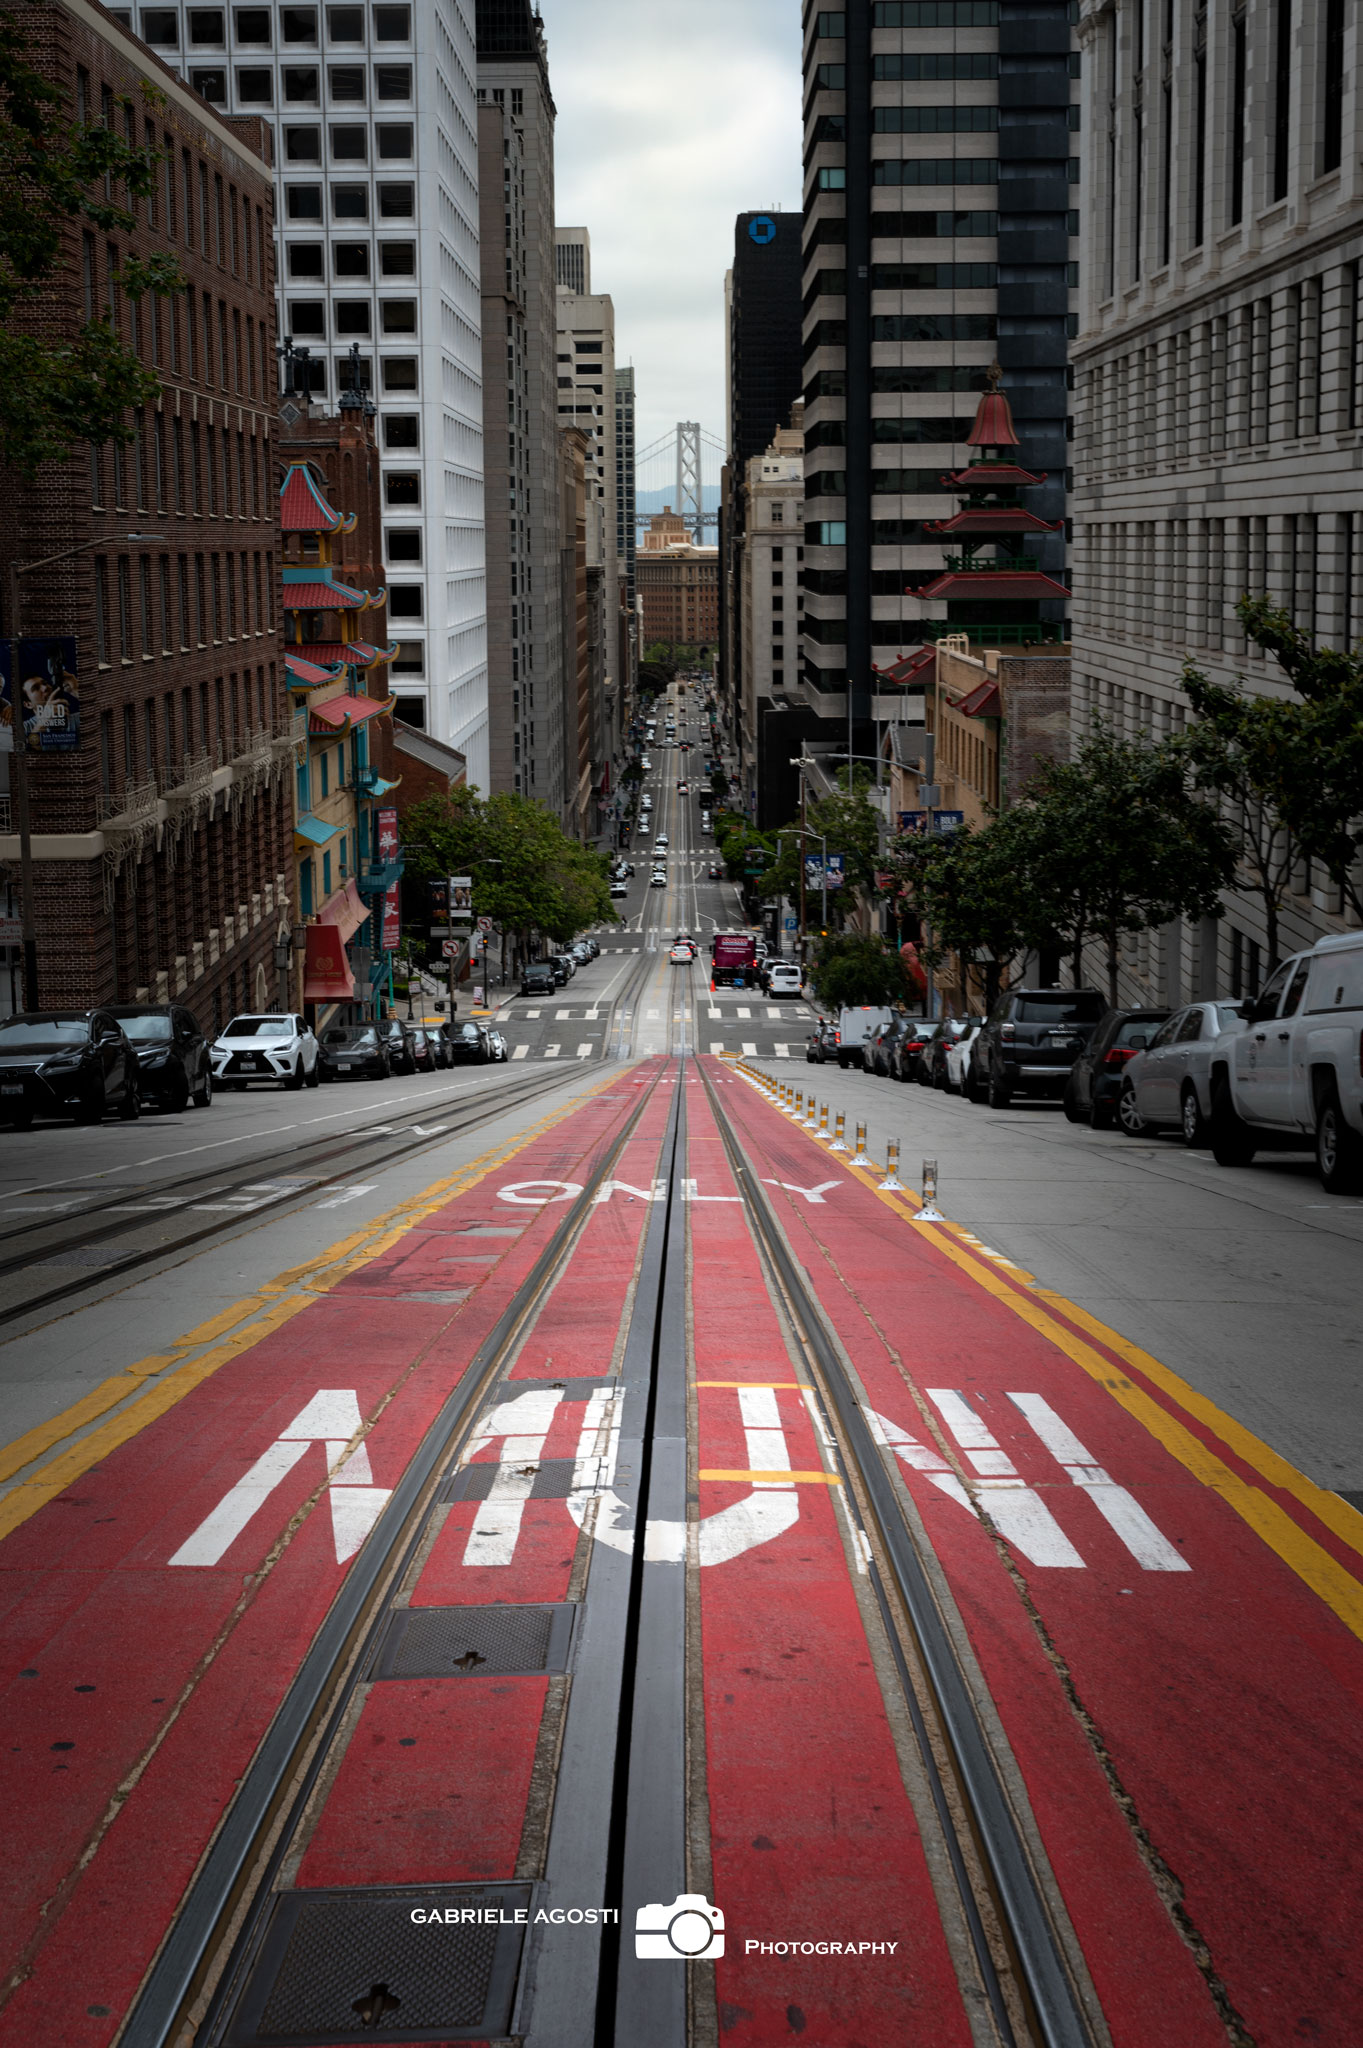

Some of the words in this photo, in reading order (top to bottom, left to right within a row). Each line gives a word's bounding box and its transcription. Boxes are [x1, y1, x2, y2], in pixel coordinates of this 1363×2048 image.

[37, 704, 65, 718] BOLD
[496, 1179, 845, 1204] ONLY
[165, 1386, 1193, 1572] MUNI
